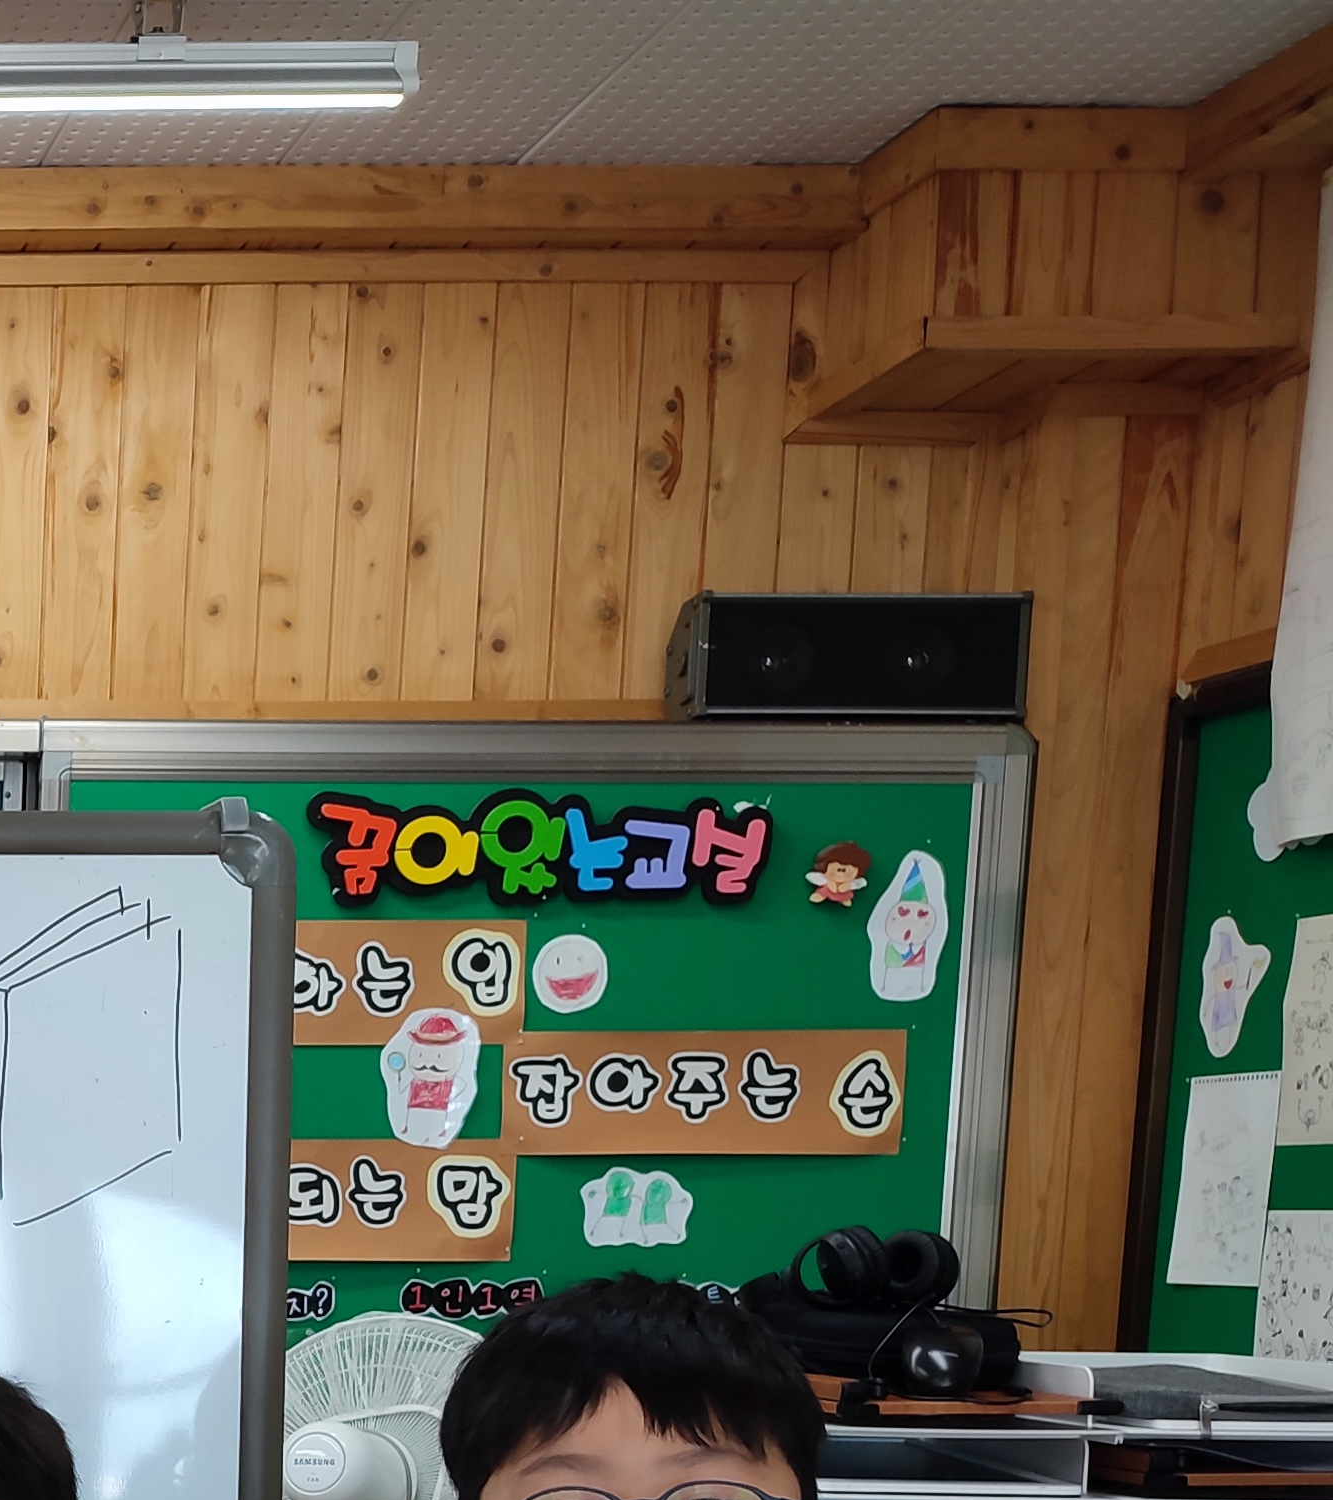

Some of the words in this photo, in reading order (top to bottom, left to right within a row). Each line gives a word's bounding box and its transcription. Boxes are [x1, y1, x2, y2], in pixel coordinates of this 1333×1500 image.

[513, 1050, 800, 1126] 잡아주는
[836, 1058, 896, 1128] 손
[294, 1457, 336, 1466] SAMSUNG
